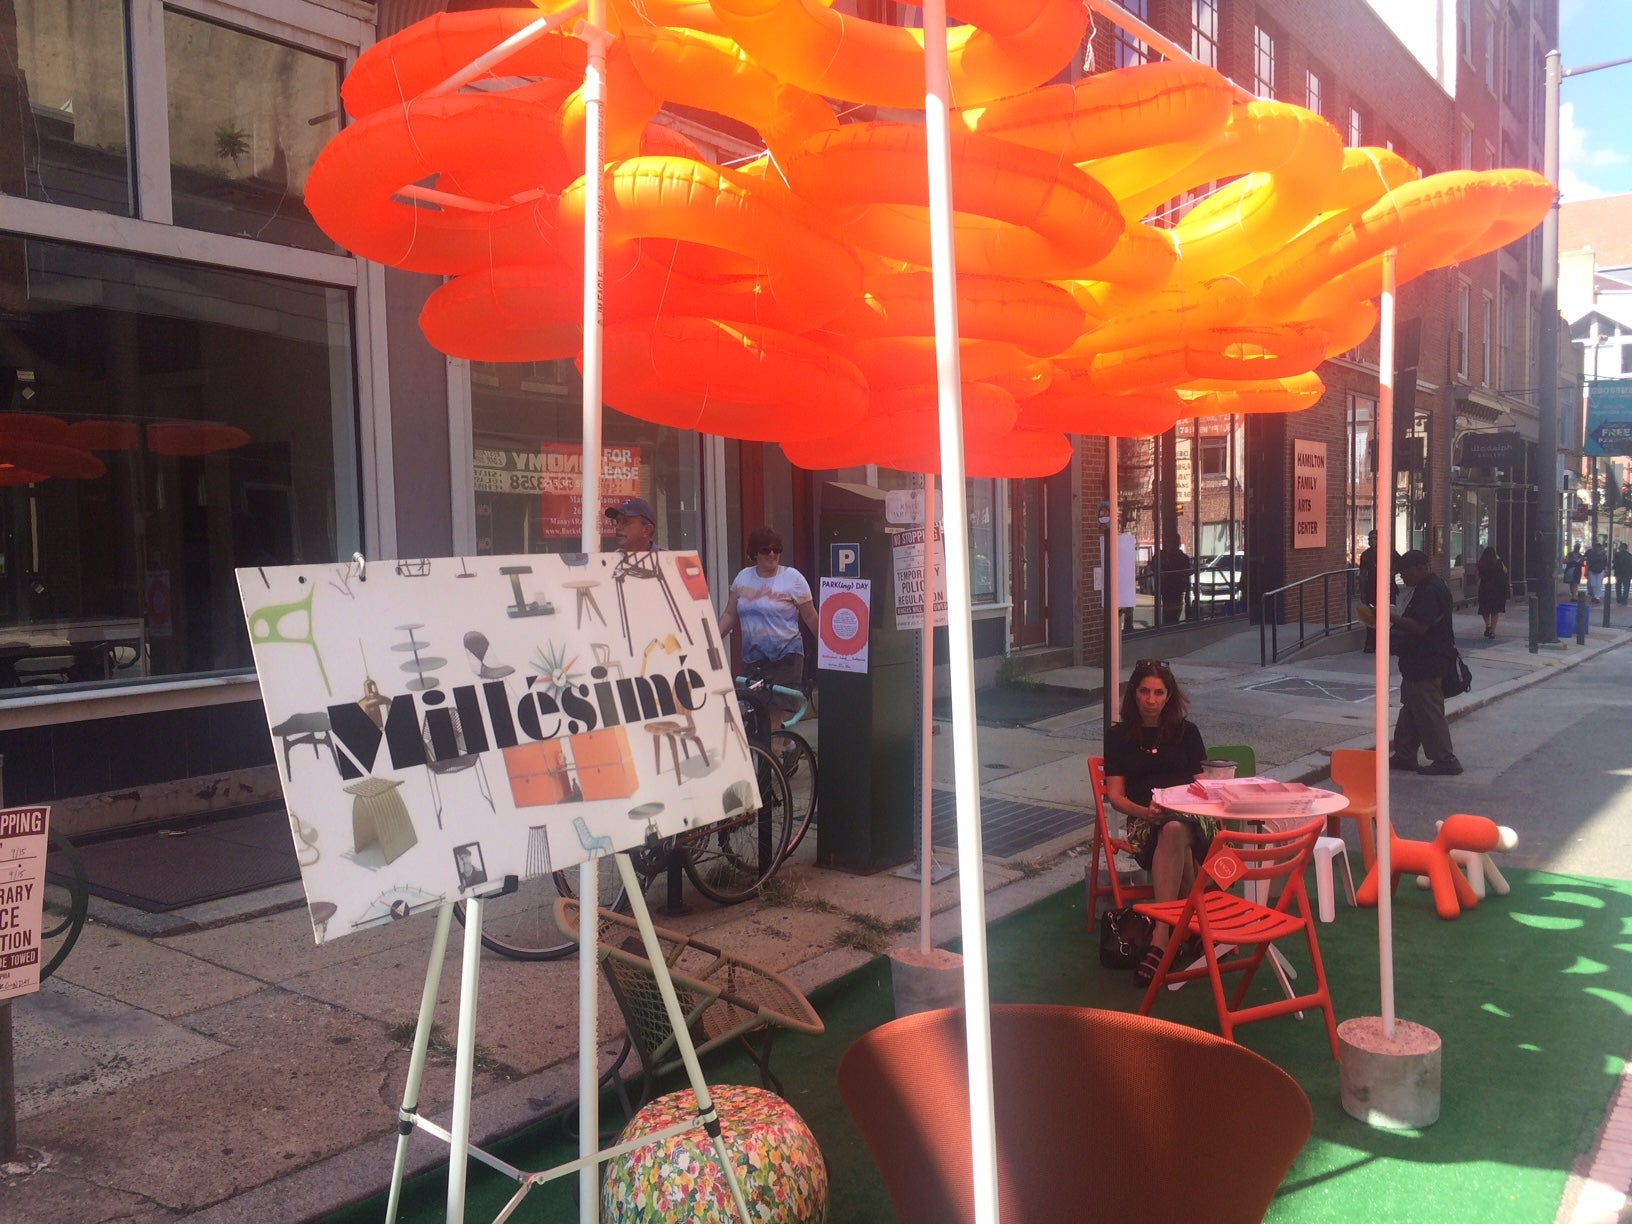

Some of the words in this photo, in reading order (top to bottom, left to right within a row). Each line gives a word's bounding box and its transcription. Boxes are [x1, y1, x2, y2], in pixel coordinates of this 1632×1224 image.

[604, 449, 632, 463] FOR
[1297, 453, 1325, 468] HAMILTON
[601, 466, 639, 480] EASE
[1297, 476, 1318, 491] FAMILY
[1297, 499, 1312, 513] ARTS
[1297, 521, 1318, 535] CENTER
[893, 533, 901, 546] NO
[902, 529, 938, 544] STOPPIG
[839, 549, 856, 572] P
[897, 567, 940, 581] TEMPORY
[822, 580, 854, 592] PARK(ing)
[856, 582, 869, 590] DAY
[327, 654, 708, 780] Millésimé
[11, 951, 36, 966] TOWED
